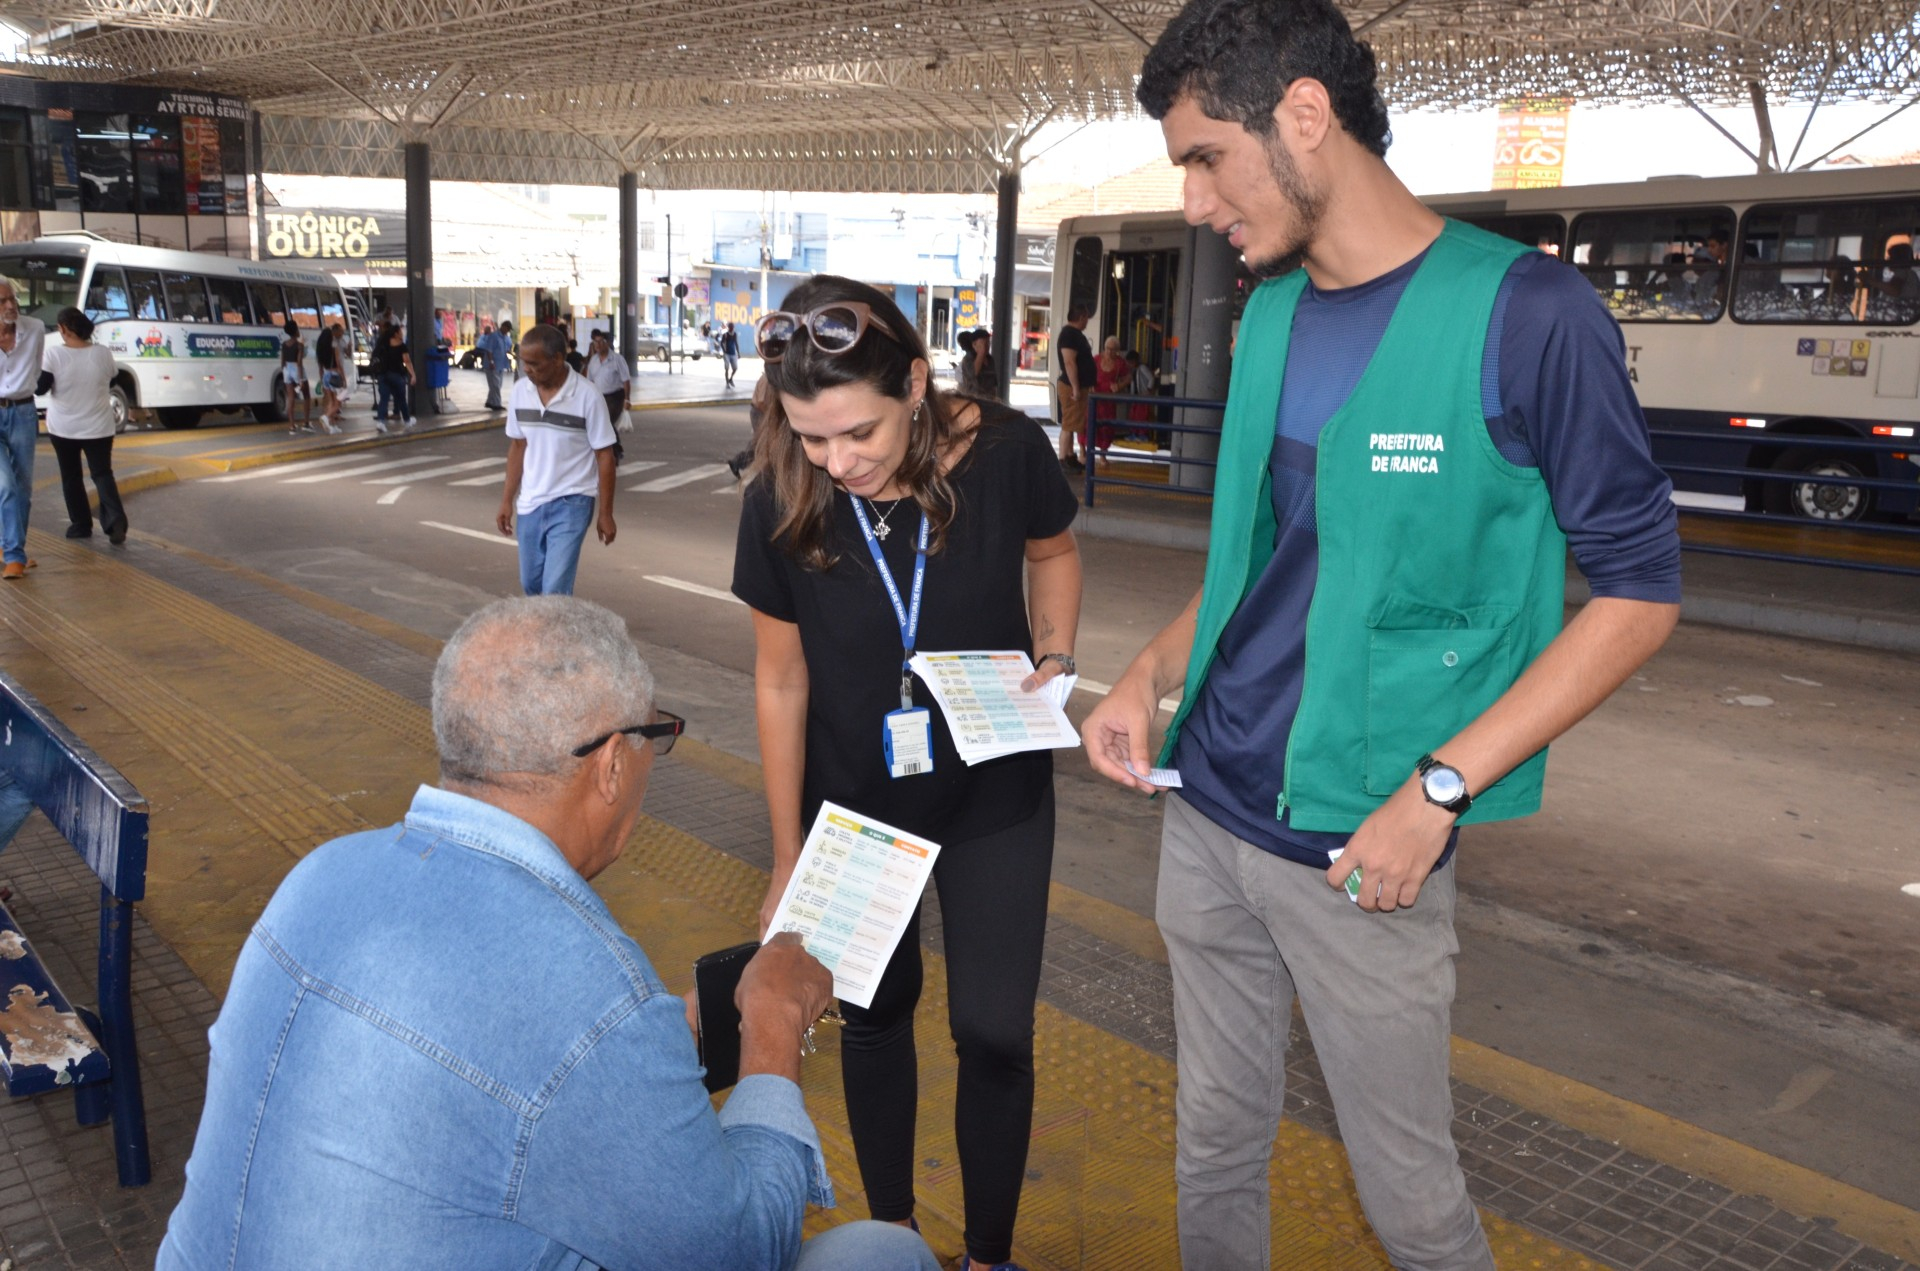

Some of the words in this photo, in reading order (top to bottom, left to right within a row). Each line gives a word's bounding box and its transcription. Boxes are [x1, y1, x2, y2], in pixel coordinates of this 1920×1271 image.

[170, 93, 214, 104] TERMINAL
[217, 98, 242, 108] CENTRAL
[157, 101, 215, 116] AYRTON
[216, 106, 246, 120] SENNA
[265, 210, 381, 235] TRÔNICA
[267, 230, 369, 257] OURO
[959, 290, 976, 302] REI
[715, 302, 732, 322] REI
[732, 304, 748, 325] DO
[962, 304, 973, 313] DO
[196, 336, 235, 351] EDUCAÇÃO
[236, 338, 273, 349] AMBIENTAL
[1369, 433, 1444, 451] PREFEITURA
[1371, 455, 1389, 472] DE
[860, 517, 873, 541] FRANCA
[914, 568, 923, 592] FRANCA
[877, 558, 896, 595] PREFEITURA
[892, 593, 899, 603] DE
[896, 602, 907, 627] FRANCA
[913, 592, 919, 601] DE
[908, 601, 918, 637] PREFEITURA
